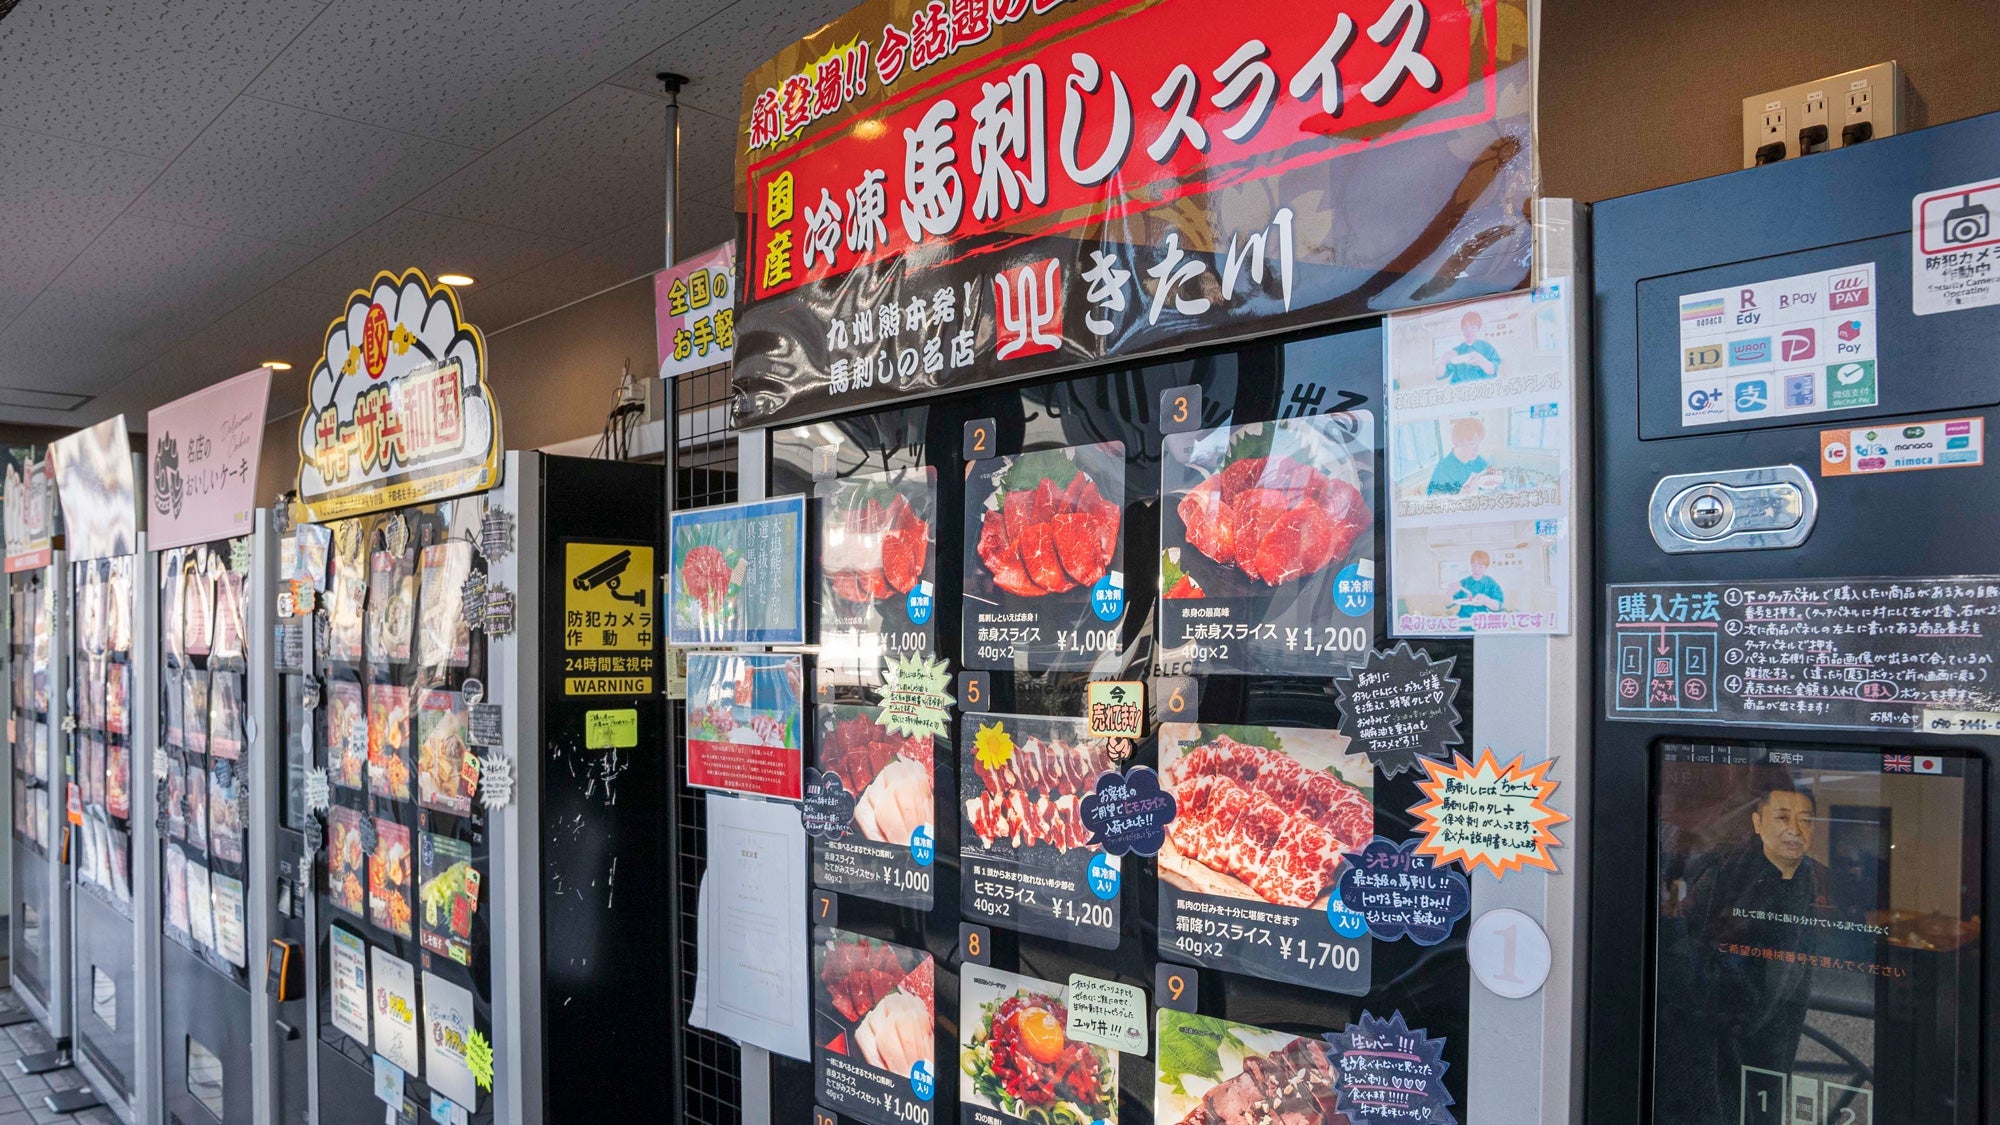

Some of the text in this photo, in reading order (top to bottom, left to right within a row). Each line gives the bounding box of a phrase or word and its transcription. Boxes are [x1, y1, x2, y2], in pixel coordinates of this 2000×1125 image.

[750, 40, 868, 149] 新登場!!
[802, 0, 1441, 270] 冷凍 馬刺しスライス
[763, 171, 795, 289] 国産
[1083, 208, 1293, 335] きた川
[668, 268, 727, 317] 全国の
[1792, 292, 1817, 306] Pay
[1836, 291, 1862, 304] PAY
[827, 281, 973, 353] 九州熊本発!
[1736, 312, 1760, 325] Edy
[1838, 343, 1861, 354] Pay
[827, 331, 975, 395] 馬刺しの名店
[1687, 350, 1720, 367] iD
[1173, 396, 1188, 422] 3
[315, 362, 463, 482] ギョーザ共和国
[187, 433, 211, 463] 名店の
[974, 428, 985, 451] 2
[1895, 443, 1933, 451] manaca
[1895, 456, 1933, 466] nimoca
[187, 458, 248, 496] おいしいケーキ
[1096, 589, 1121, 600] 保冷剤
[1339, 580, 1373, 593] 保冷剤
[1744, 585, 2000, 602] 下のタッチパネルで購入したい商品がある方の自販
[910, 597, 929, 606] 保冷剤
[1101, 602, 1117, 614] 入り
[1345, 595, 1366, 607] 入り
[1617, 592, 1721, 622] 購入方法
[568, 610, 652, 627] 防犯カメラ
[914, 608, 926, 617] 入り
[978, 613, 1038, 622] 馬刺しといえば赤身!
[1182, 608, 1229, 618] 赤身の最高峰
[1400, 612, 1555, 631] 臭みなんて一切無いです!
[978, 627, 1041, 642] 赤身スライス
[1181, 624, 1278, 640] 上赤身スライス
[1286, 627, 1366, 656] ¥1,200
[881, 632, 926, 653] ¥1,000
[1057, 630, 1117, 655] ¥1,000
[978, 646, 1014, 661] 40g×2
[1181, 645, 1228, 662] 40g×2
[1628, 655, 1635, 668] 1
[1689, 655, 1700, 668] 2
[565, 657, 653, 672] 24時間監視中
[574, 679, 644, 693] WARNING
[968, 680, 979, 703] 5
[1110, 686, 1126, 703] 今
[1651, 680, 1674, 690] タッチ
[1169, 687, 1184, 713] 6
[1650, 691, 1677, 702] パネル
[1092, 703, 1142, 732] 売れてます!
[1769, 752, 1803, 764] 販売中
[1099, 784, 1136, 802] お客様の
[1445, 778, 1537, 794] 馬刺しには ちゃーんと
[1105, 814, 1153, 835] 入荷しました!!
[914, 837, 932, 849] 保冷剤
[824, 852, 855, 865] 赤身スライス
[917, 849, 929, 859] 入り
[1367, 852, 1424, 872] シモフリは
[824, 863, 880, 880] たてがみスライスセット
[883, 866, 929, 892] ¥1,000
[973, 865, 1075, 891] 馬1頭からあまり取れない希少部位
[1092, 866, 1116, 881] 保冷剤
[1353, 869, 1449, 891] 最上級の馬刺し!!
[974, 880, 1035, 904] ヒモスライス
[1097, 881, 1112, 893] 入り
[821, 898, 831, 918] 7
[974, 898, 1009, 916] 40g×2
[1053, 897, 1112, 928] ¥1,200
[1176, 899, 1299, 927] 馬肉の甘みを十分に堪能できます
[1176, 916, 1272, 946] 霜降りスライス
[1339, 916, 1359, 928] 入り
[1732, 907, 1889, 936] 決して激辛に振り分けている訳ではなく
[969, 933, 980, 955] 8
[1176, 937, 1223, 957] 40g×2
[1280, 936, 1359, 971] ¥1,700
[1494, 924, 1524, 980] 1
[1718, 943, 1905, 977] ご希望の機械番号を選んでください
[1167, 975, 1185, 1000] 9
[826, 1068, 856, 1087] 赤身スライス
[826, 1078, 881, 1106] たてがみスライスセット
[916, 1083, 928, 1094] 入り
[884, 1093, 929, 1125] ¥1,000
[1758, 1090, 1767, 1112] 1
